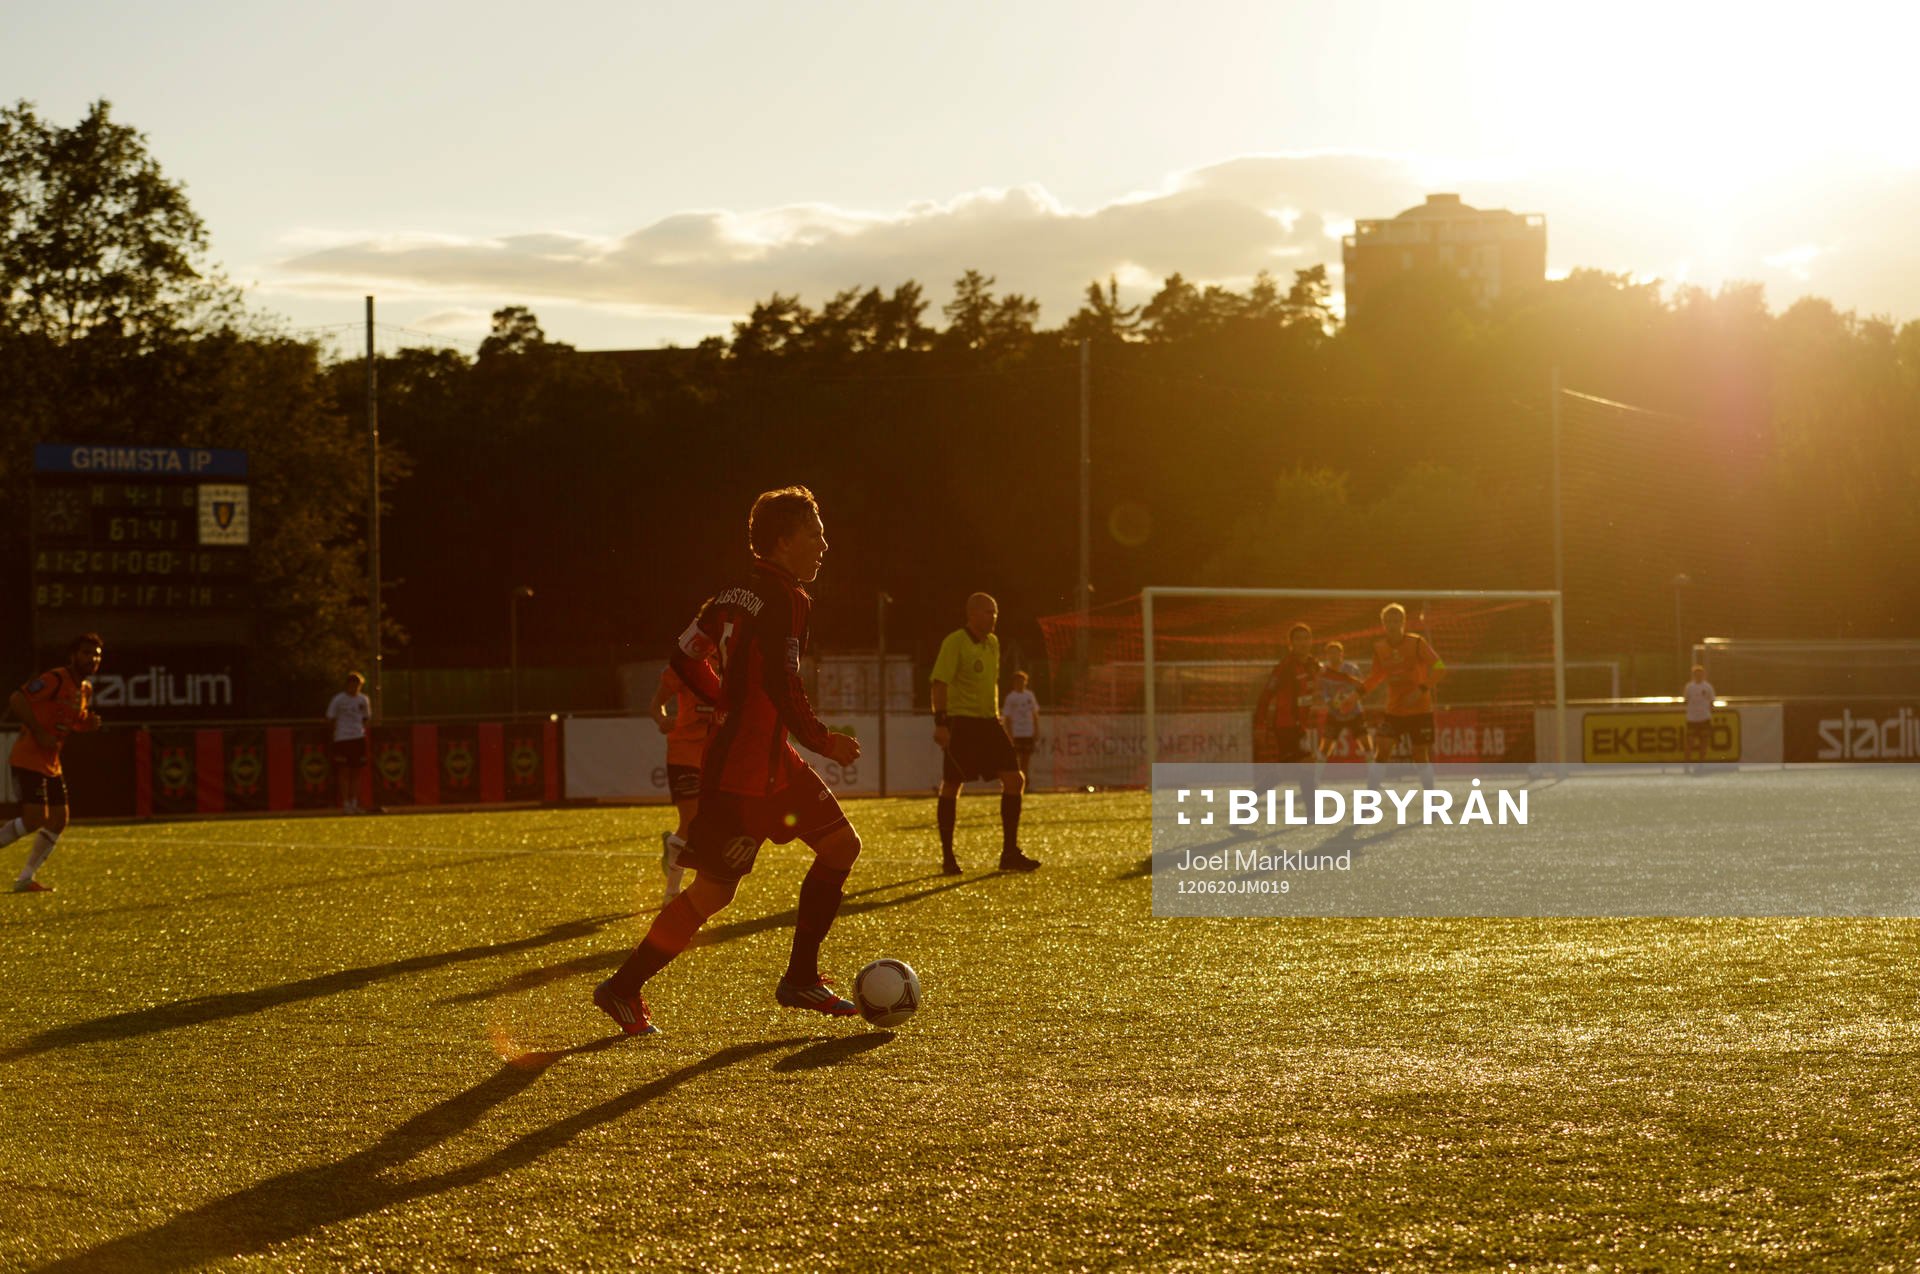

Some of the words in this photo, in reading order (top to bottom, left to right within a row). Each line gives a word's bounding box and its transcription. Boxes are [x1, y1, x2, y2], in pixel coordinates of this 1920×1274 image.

[71, 446, 182, 472] GRIMSTA
[189, 450, 213, 472] IP
[88, 665, 232, 707] adium
[1592, 716, 1733, 755] EKESIÖ
